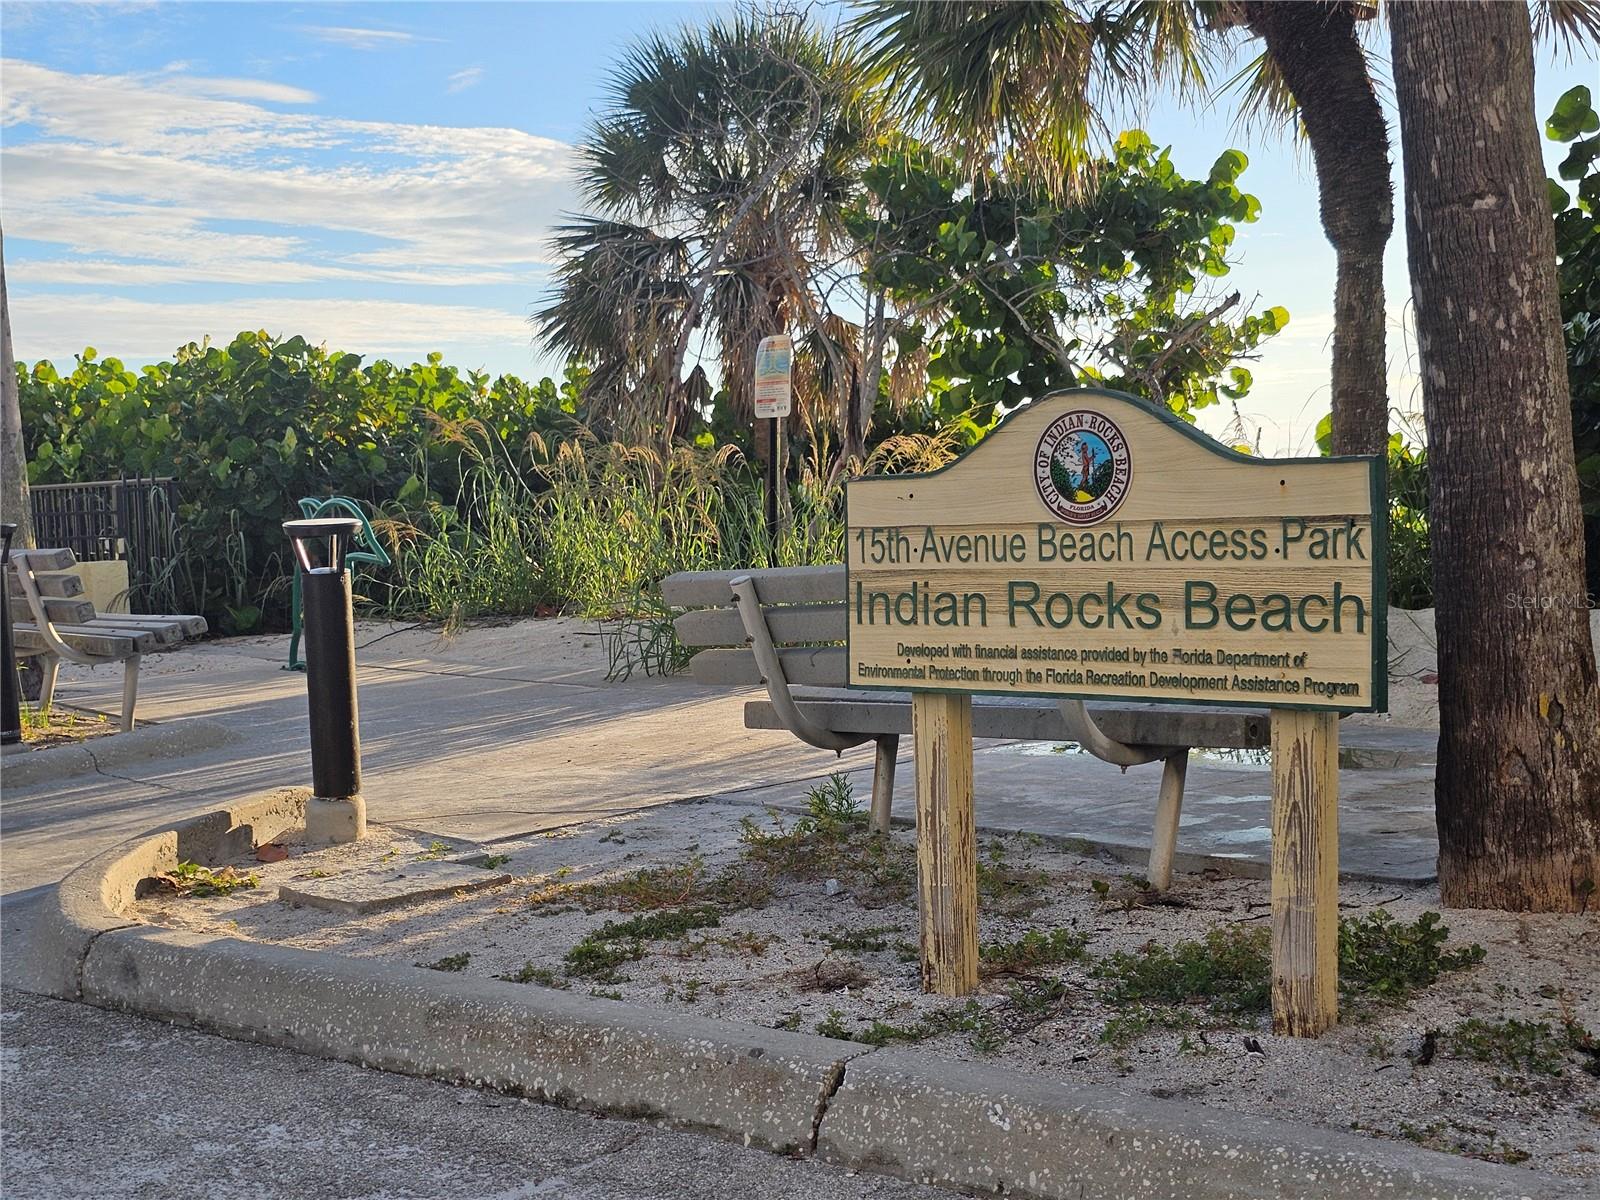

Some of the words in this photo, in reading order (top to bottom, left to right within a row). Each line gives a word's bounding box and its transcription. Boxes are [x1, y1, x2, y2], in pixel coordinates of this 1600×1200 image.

[1044, 415, 1084, 449] INDIAN
[1089, 415, 1124, 453] ROCKS
[1038, 451, 1050, 468] OF
[1039, 475, 1060, 505] CITY
[1104, 457, 1127, 505] BEACH
[1069, 504, 1095, 512] FLORIDA
[856, 527, 910, 563] 15th
[920, 526, 1026, 563] Avenue
[1037, 523, 1134, 562] Beach
[1146, 522, 1268, 561] Access
[1282, 518, 1366, 560] Park
[856, 581, 987, 626] Indian
[1008, 580, 1162, 629] Rocks
[1185, 580, 1366, 634] Beach
[897, 643, 949, 660] Developed
[952, 644, 972, 658] with
[975, 644, 1017, 659] financial
[1021, 646, 1077, 661] assistance
[1081, 647, 1129, 663] provided
[1133, 648, 1147, 667] by
[1150, 649, 1168, 663] the
[1172, 648, 1213, 665] Florida
[1216, 650, 1290, 670] Department
[1293, 651, 1308, 668] of
[858, 663, 926, 680] Environmental
[929, 665, 979, 681] Protection
[982, 667, 1022, 686] through
[1025, 668, 1042, 682] the
[1045, 669, 1083, 685] Florida
[1086, 670, 1146, 687] Recreation
[1150, 672, 1228, 693] Development
[1232, 675, 1300, 694] Assistance
[1304, 677, 1359, 697] Program
